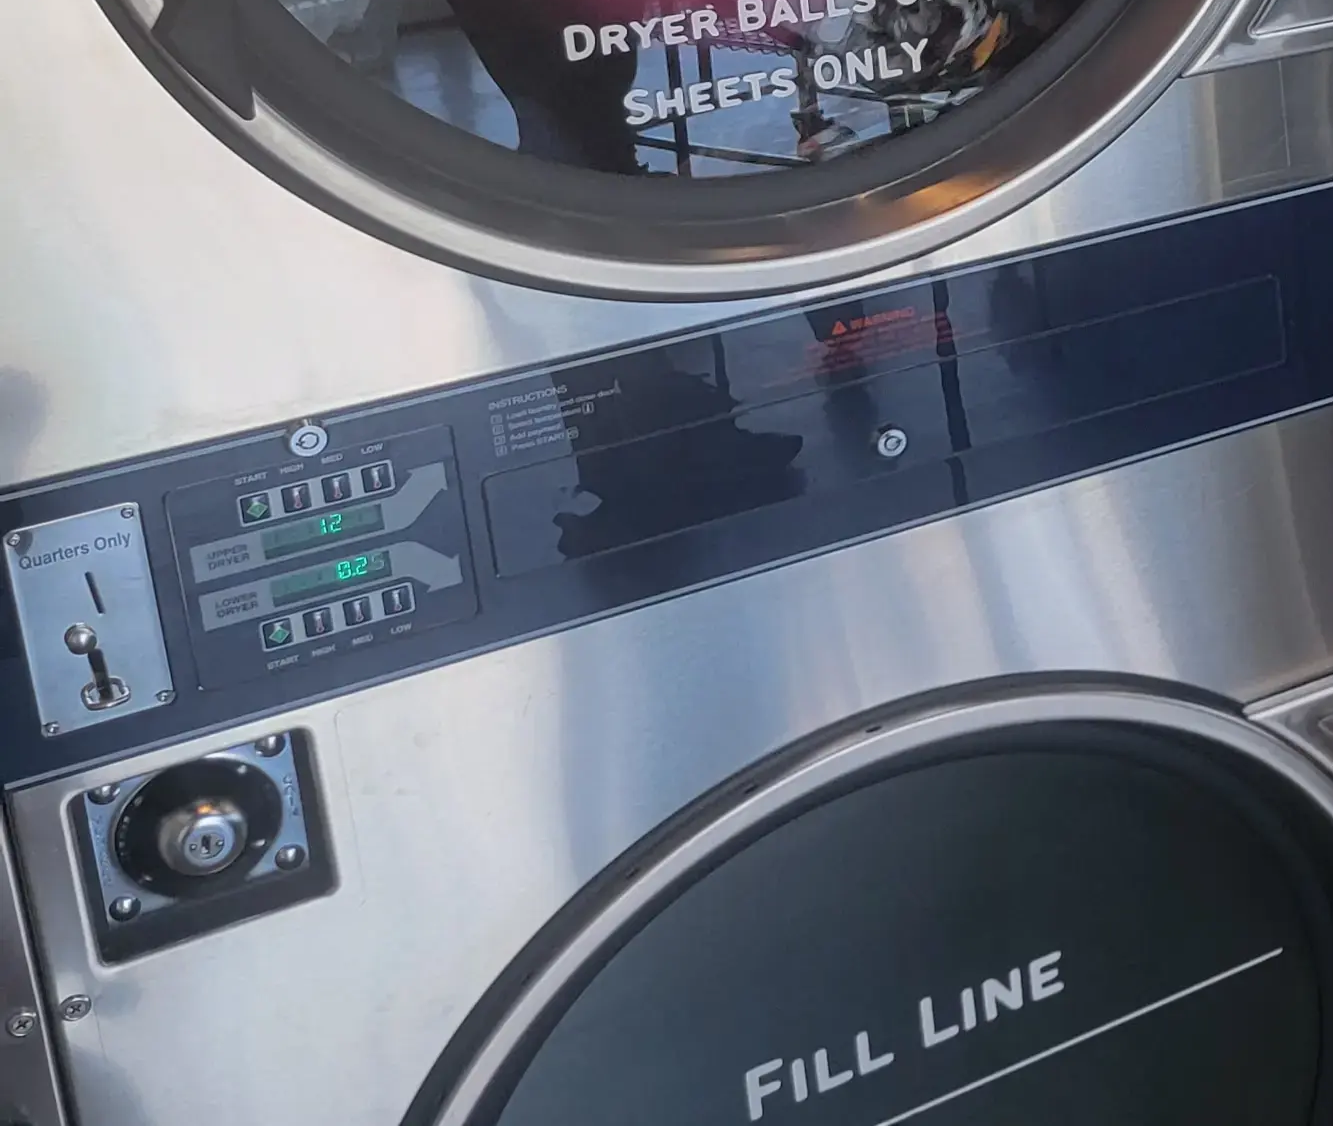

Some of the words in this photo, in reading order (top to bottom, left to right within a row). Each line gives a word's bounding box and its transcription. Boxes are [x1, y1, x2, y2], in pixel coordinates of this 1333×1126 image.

[563, 0, 720, 63] DRYER
[623, 66, 797, 126] SHEETS
[814, 37, 931, 92] ONLY
[488, 384, 568, 411] INSTRUCTIONS
[234, 471, 268, 486] START
[360, 442, 384, 455] LOW
[319, 513, 342, 535] 12
[18, 542, 90, 572] Quarters
[94, 530, 131, 555] Only
[208, 552, 250, 571] DRYER
[216, 600, 259, 618] DRYER
[390, 622, 412, 635] LOW
[745, 1030, 894, 1121] FILL
[919, 950, 1065, 1048] LINE
